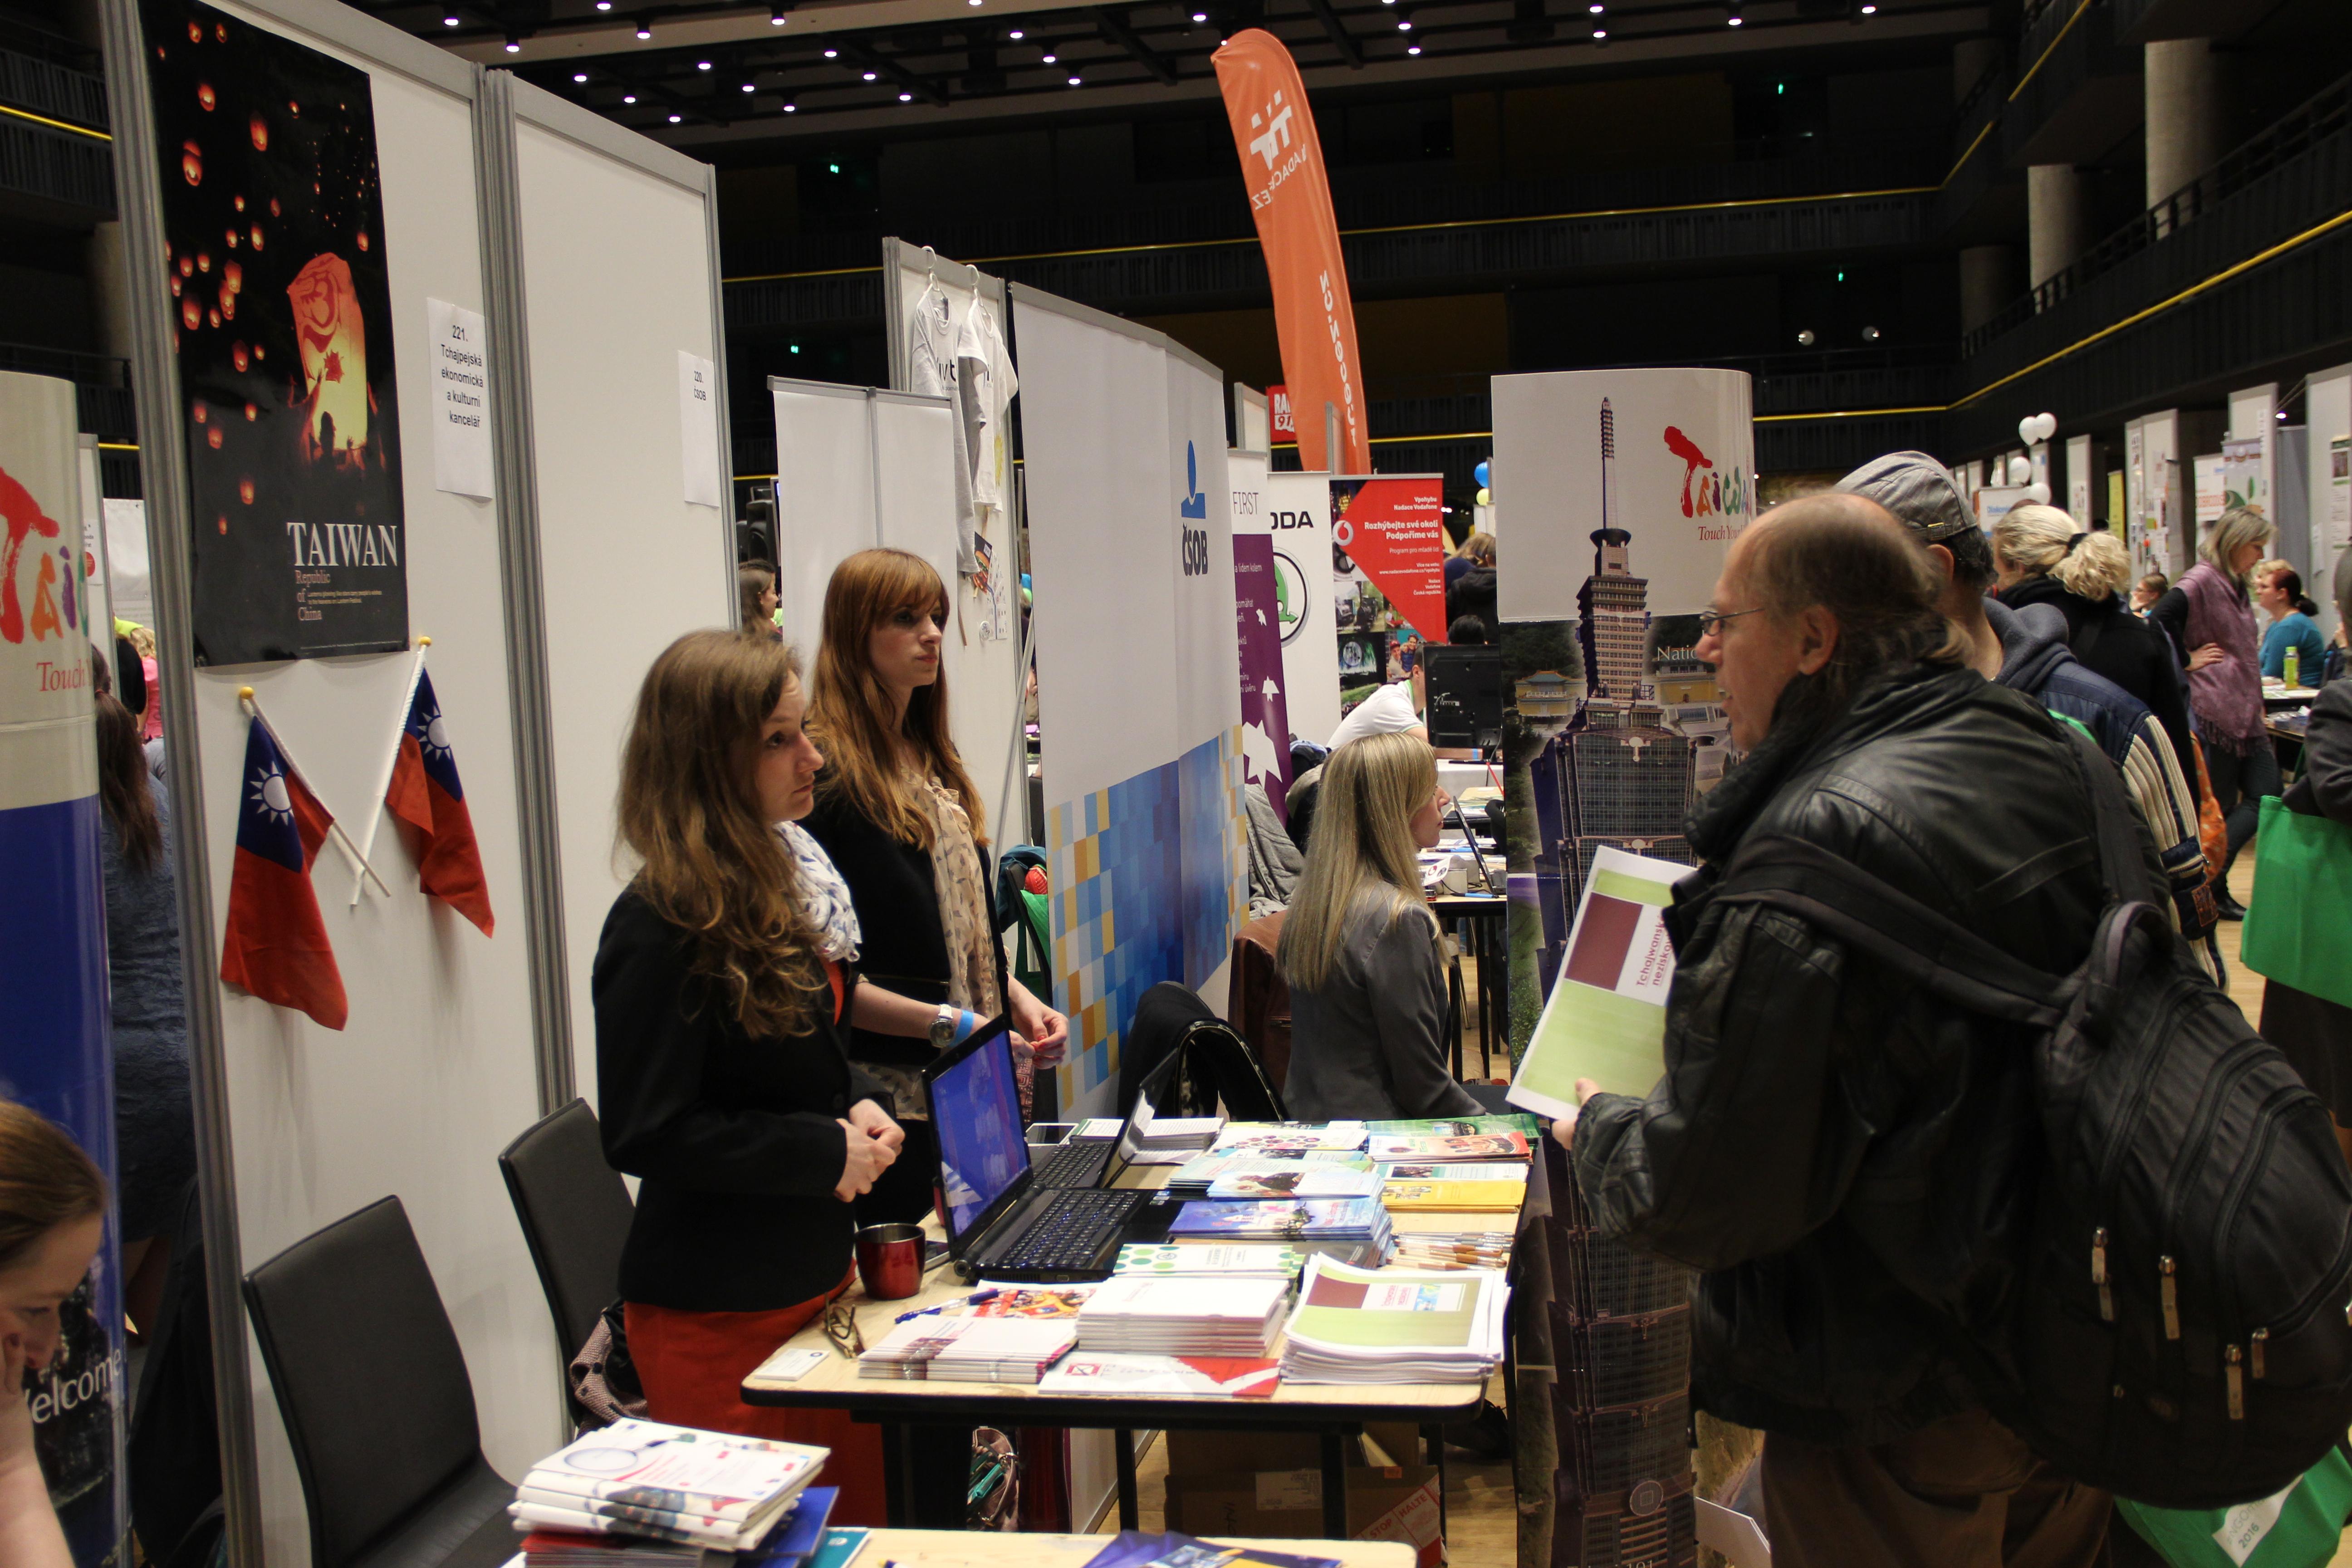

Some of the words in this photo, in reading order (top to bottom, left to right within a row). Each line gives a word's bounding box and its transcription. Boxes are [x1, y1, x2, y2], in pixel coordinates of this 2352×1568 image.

[452, 324, 468, 342] 221.
[441, 344, 482, 367] Tchajpejská
[441, 367, 483, 388] ekonomická
[447, 392, 451, 401] a
[453, 390, 480, 408] kulturní
[694, 386, 706, 401] ČSOB
[450, 410, 480, 428] kancelář
[1232, 491, 1259, 515] FIRST
[1364, 521, 1405, 530] Rozhýbejte
[1406, 519, 1419, 528] své
[1698, 525, 1725, 540] Touch
[286, 522, 397, 567] TAIWAN
[1182, 522, 1208, 576] ČSOB
[295, 569, 331, 588] Republic
[297, 588, 307, 603] of
[298, 606, 323, 621] China
[36, 659, 86, 692] Touch
[24, 1348, 123, 1425] elcome
[1370, 1519, 1392, 1538] STOP
[1398, 1494, 1427, 1517] HALTE
[2239, 1522, 2259, 1548] 2016
